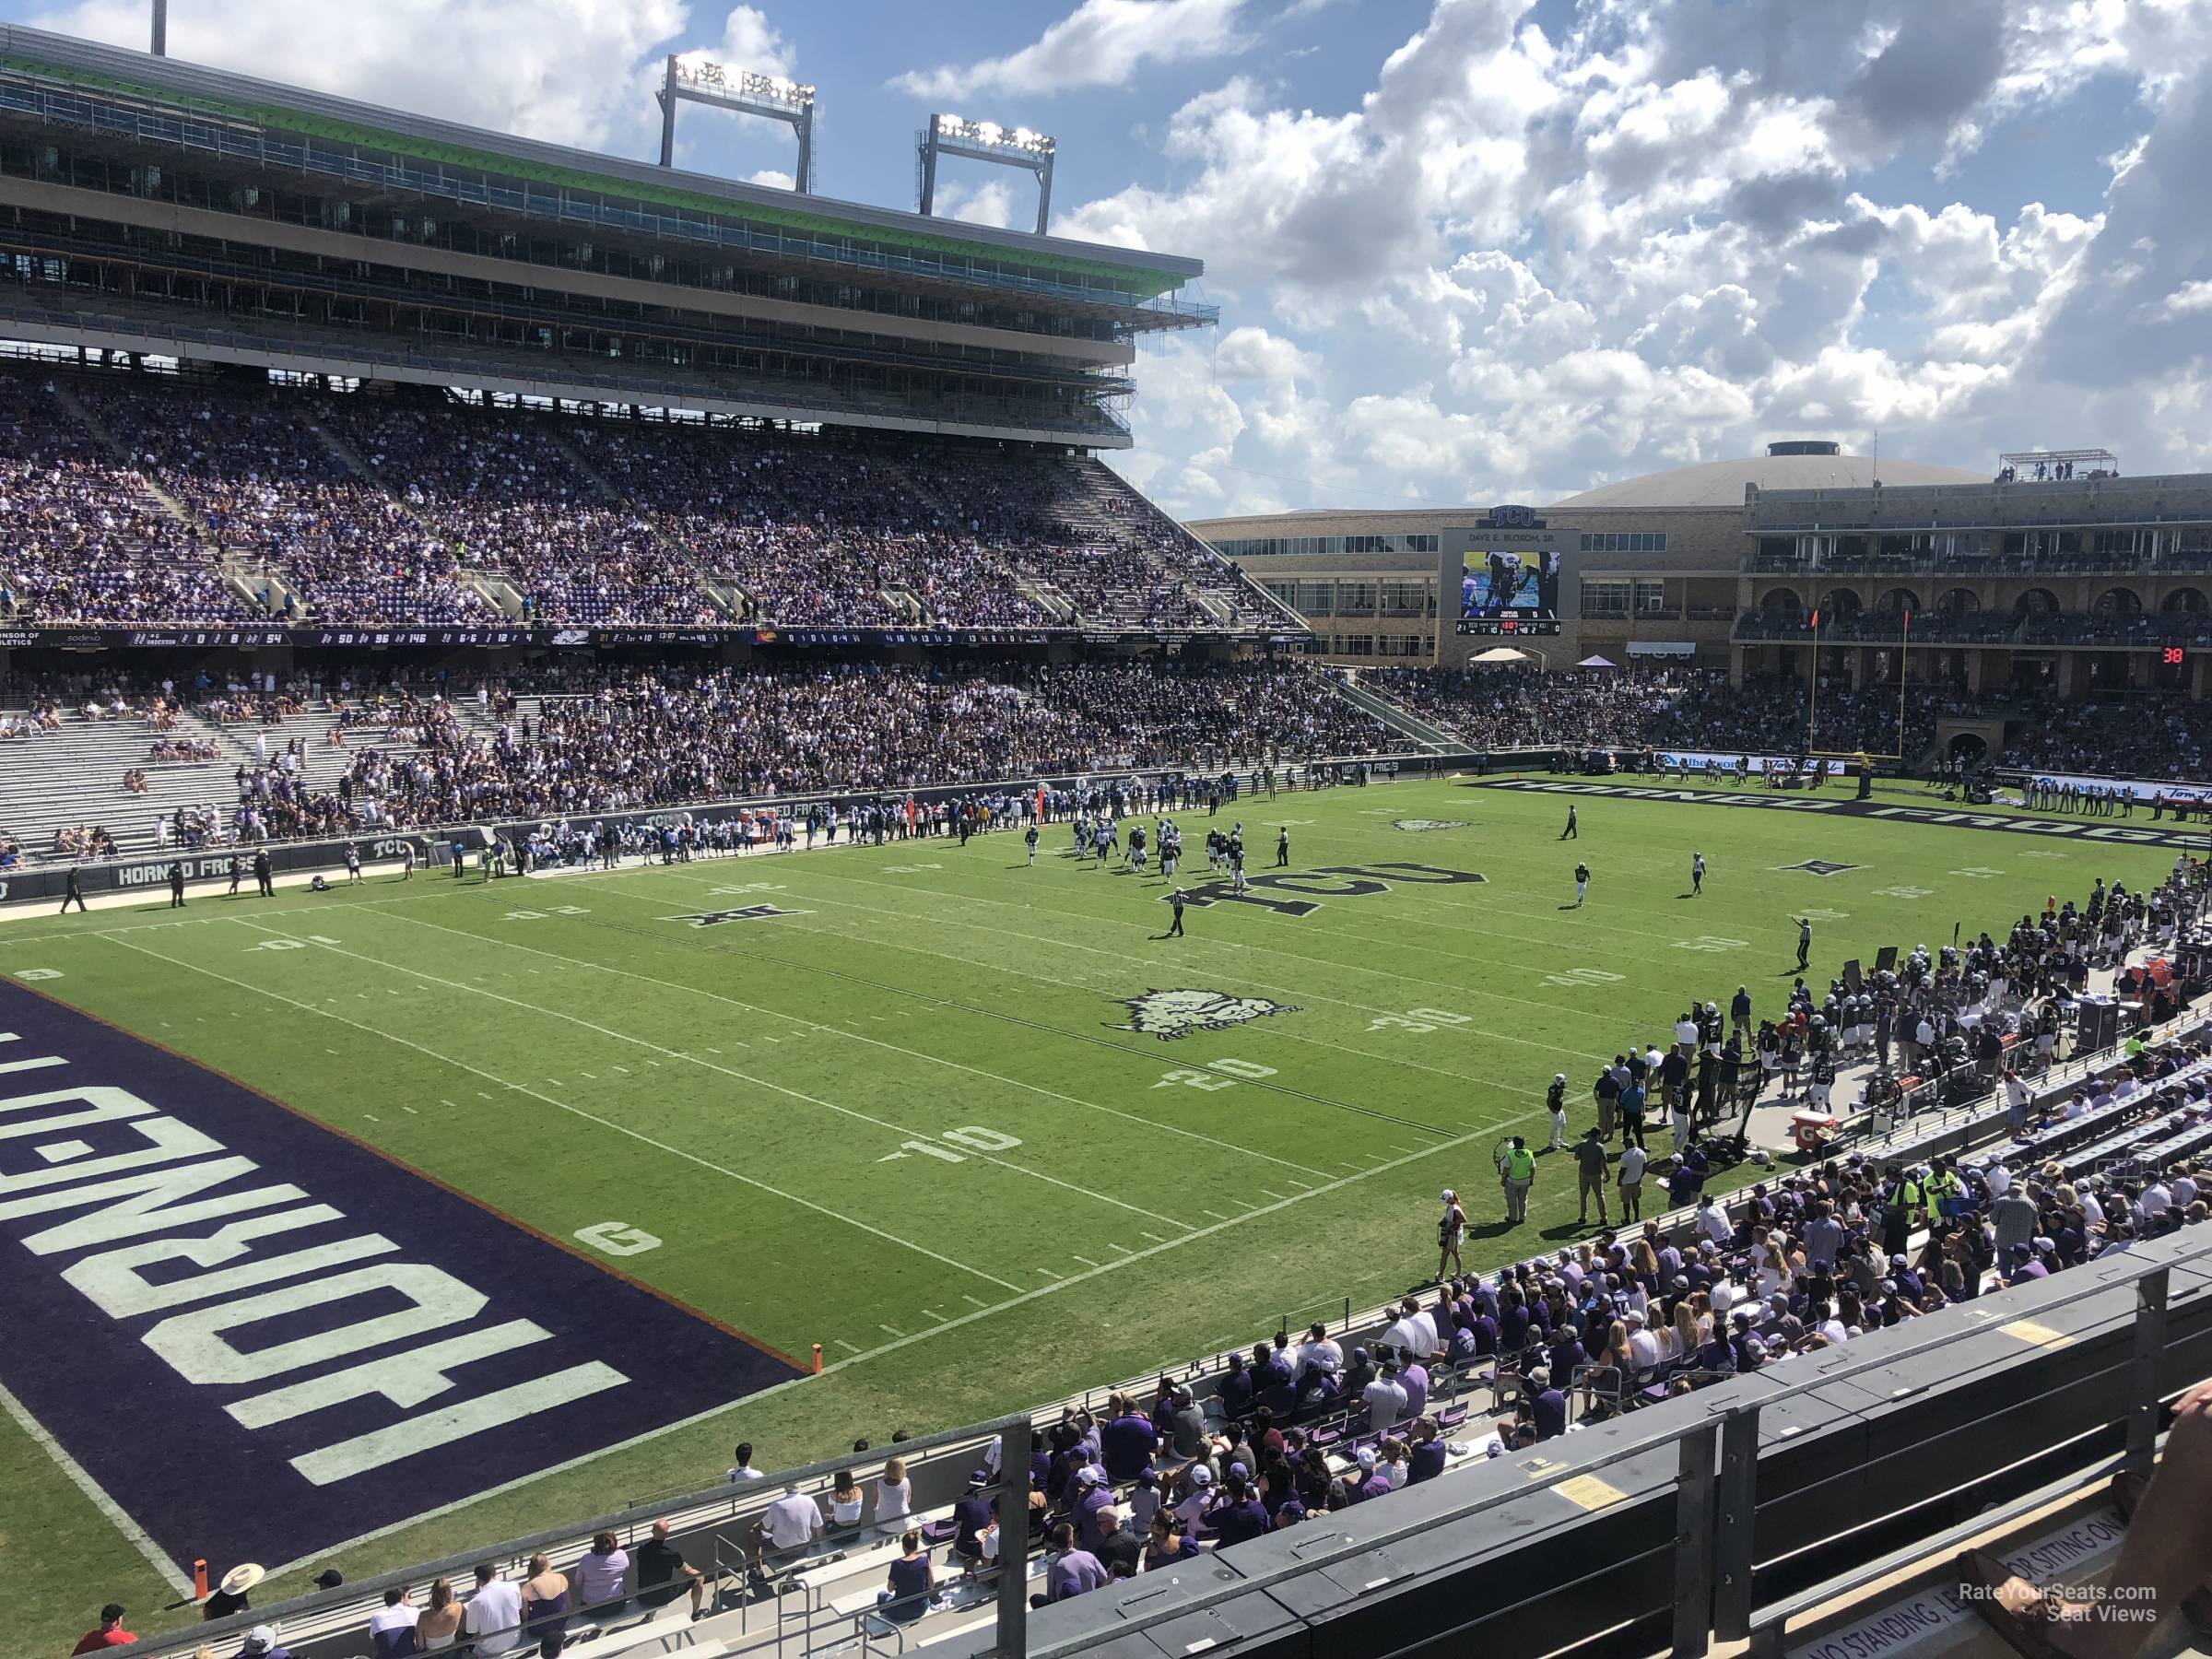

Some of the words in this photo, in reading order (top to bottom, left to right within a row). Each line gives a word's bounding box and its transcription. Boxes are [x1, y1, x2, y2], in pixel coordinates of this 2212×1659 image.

[1494, 505, 1535, 527] TCU
[1469, 534, 1490, 542] DAVE
[265, 634, 282, 643] 54
[338, 634, 353, 643] 50
[374, 634, 389, 643] 96
[409, 634, 427, 643] 146
[498, 633, 508, 642] 12
[525, 633, 533, 642] 4
[2163, 647, 2183, 664] 38
[1491, 781, 1844, 809] HORNED
[373, 839, 406, 859] TCU
[119, 861, 194, 885] HORND
[1155, 862, 1488, 918] TCU
[1371, 1007, 1473, 1033] 30
[1160, 1058, 1279, 1092] 20
[900, 1125, 1023, 1163] 10
[1800, 1125, 1815, 1142] G
[573, 1221, 663, 1256] G
[1540, 1349, 1553, 1371] 5
[2006, 1556, 2044, 1581] OR
[2030, 1530, 2097, 1570] SITTING
[2086, 1517, 2122, 1542] ON
[1842, 1602, 1950, 1659] STANDING,
